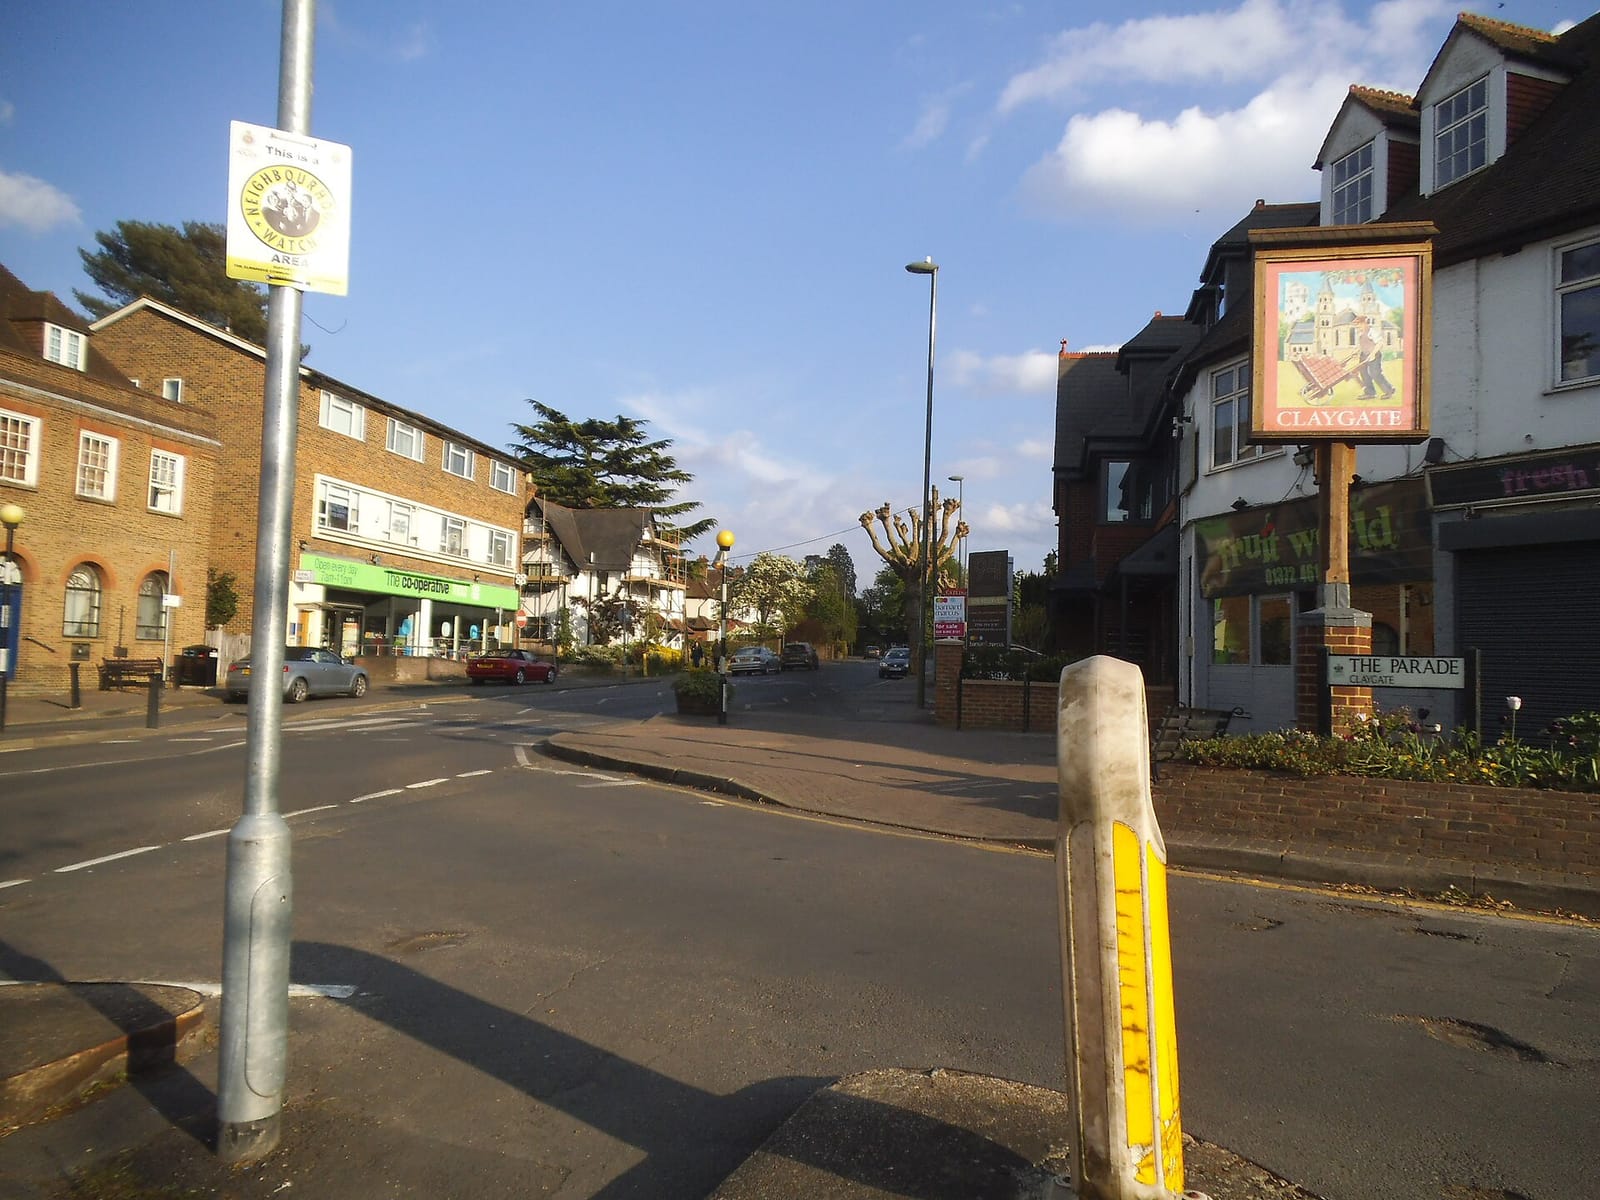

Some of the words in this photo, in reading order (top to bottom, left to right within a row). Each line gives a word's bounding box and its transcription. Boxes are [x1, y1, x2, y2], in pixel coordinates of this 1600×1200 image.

[265, 145, 294, 160] This
[270, 254, 309, 268] AREA
[1276, 410, 1402, 427] CLAYGATE
[1287, 505, 1398, 559] wld
[314, 558, 331, 573] Open
[331, 562, 347, 575] every
[347, 565, 358, 577] day
[386, 572, 400, 587] The
[401, 576, 450, 595] co-operative
[1265, 568, 1297, 586] 01372
[1349, 658, 1381, 673] THE
[1391, 658, 1460, 675] PARADE
[1349, 674, 1395, 685] CLAYGATE
